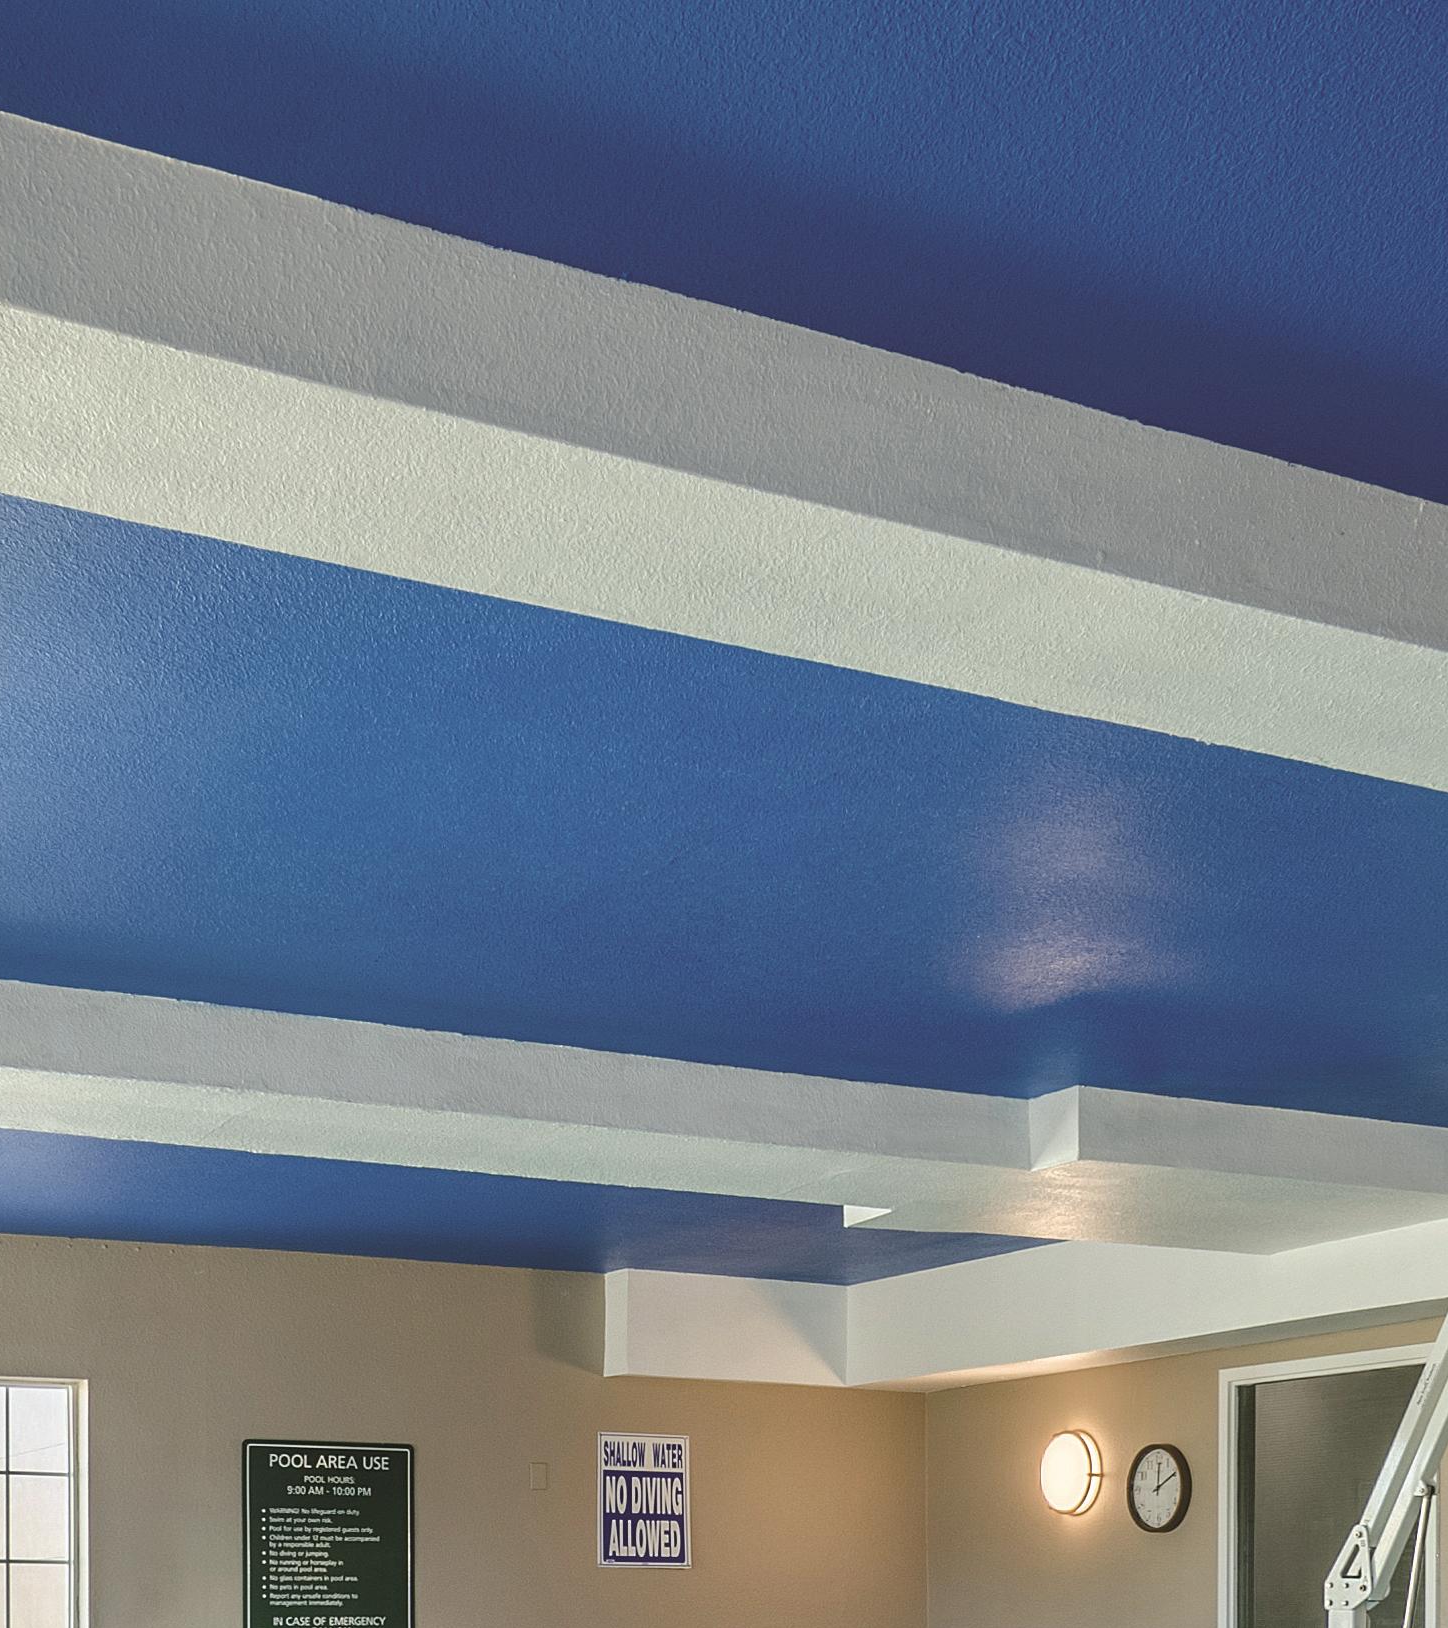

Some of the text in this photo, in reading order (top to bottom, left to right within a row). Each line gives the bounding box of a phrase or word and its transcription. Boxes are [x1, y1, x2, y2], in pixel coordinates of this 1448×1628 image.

[269, 1453, 390, 1470] POOL AREA USE
[604, 1440, 683, 1469] SHALLOW WATER
[287, 1485, 306, 1495] 9:00
[308, 1486, 324, 1495] AM
[333, 1487, 355, 1496] 10:00
[357, 1488, 371, 1496] PM
[606, 1475, 682, 1515] NO DIVING
[609, 1519, 681, 1558] ALLOWED
[273, 1616, 387, 1626] IN CASE OF EMERGENCY
